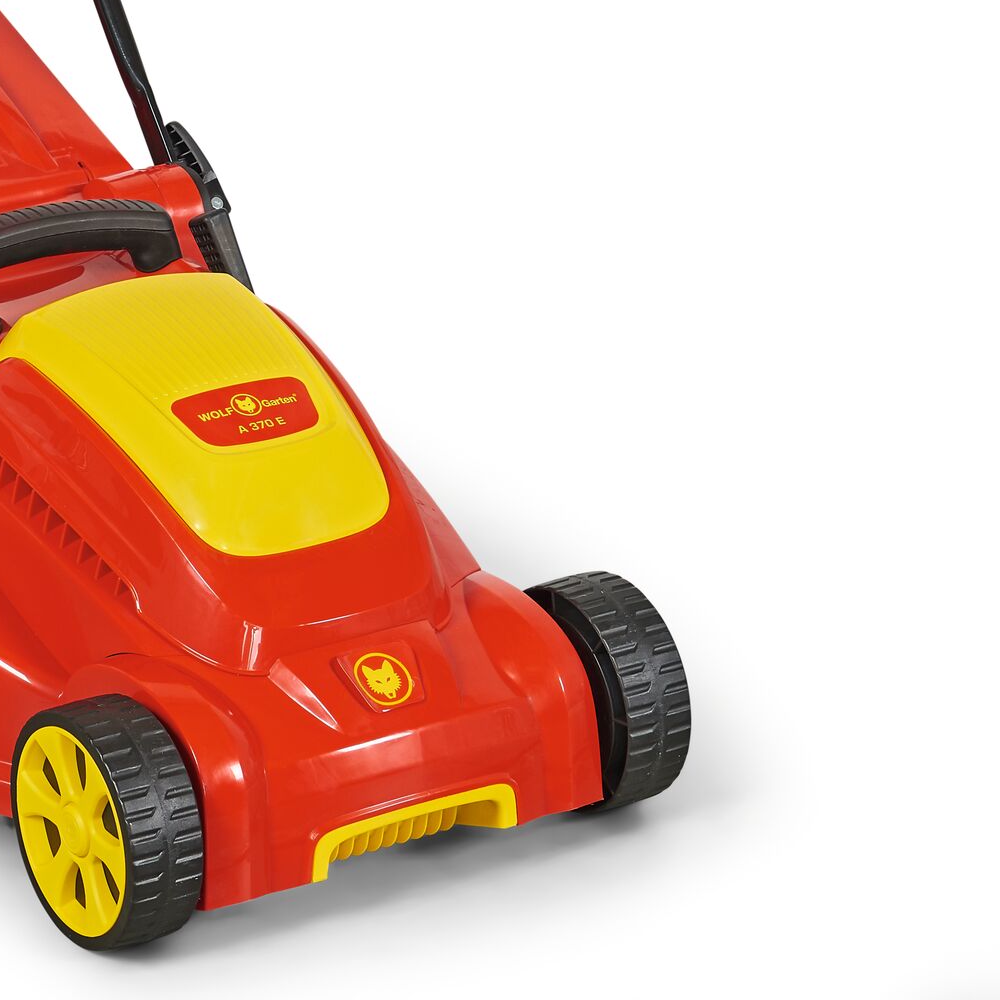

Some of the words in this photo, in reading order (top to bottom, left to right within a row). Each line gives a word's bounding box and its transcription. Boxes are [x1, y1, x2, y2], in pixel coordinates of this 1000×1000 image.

[197, 407, 234, 422] WOLF
[261, 395, 297, 408] Garten
[238, 425, 249, 434] A
[249, 418, 275, 432] 370
[275, 416, 287, 426] E
